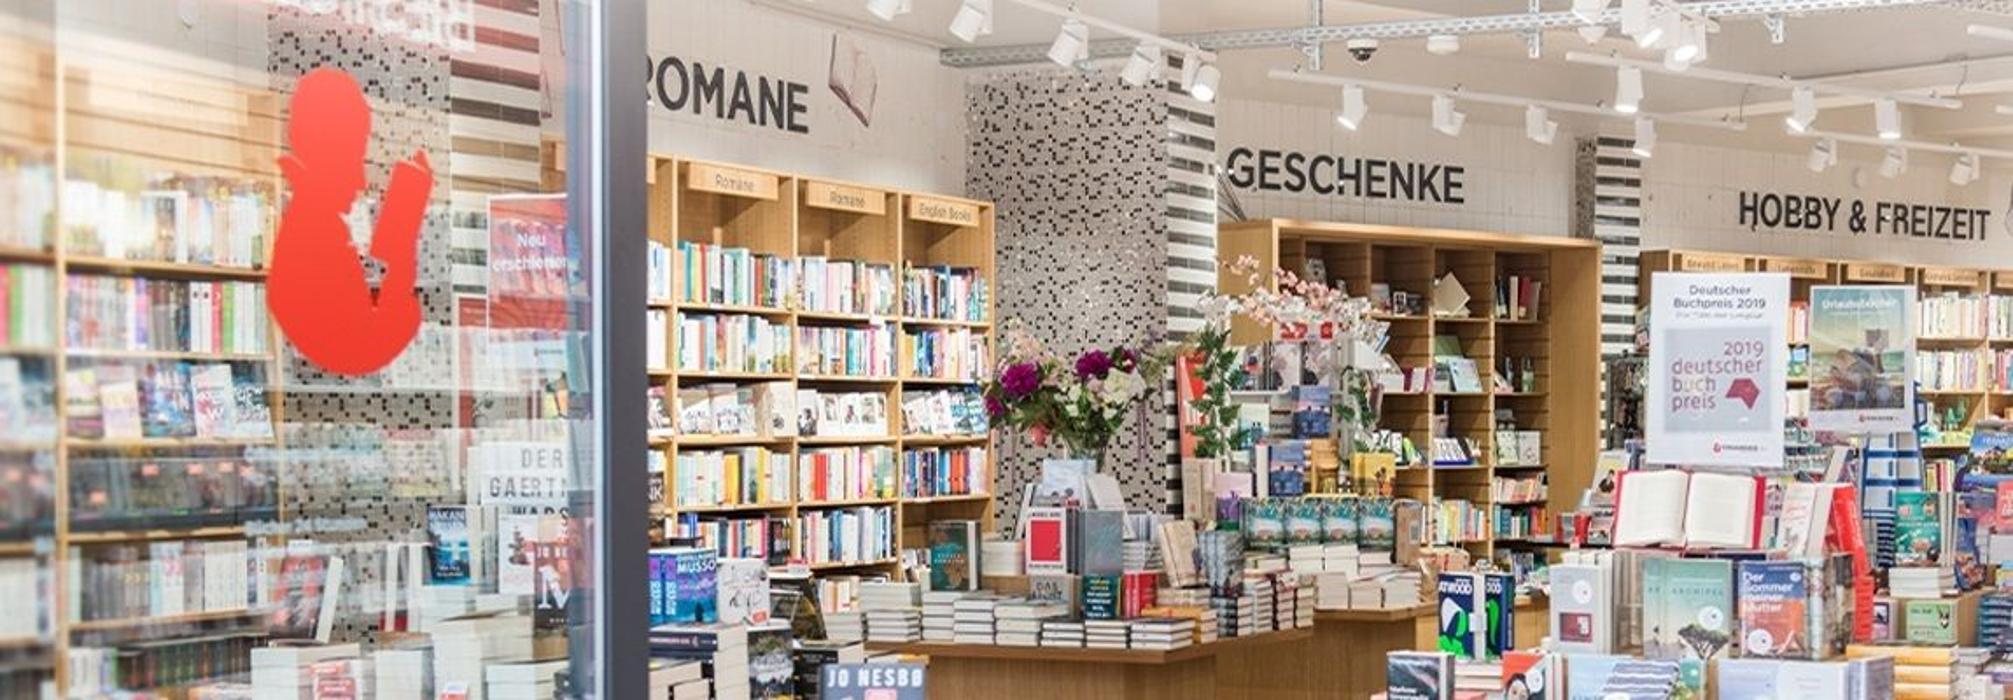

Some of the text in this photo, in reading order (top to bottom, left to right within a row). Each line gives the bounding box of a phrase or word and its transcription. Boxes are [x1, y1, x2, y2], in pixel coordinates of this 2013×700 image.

[1227, 147, 1465, 204] GESCHENKE
[1739, 191, 1991, 241] HOBBY & FREIZEIT
[516, 233, 546, 247] Neu
[1689, 284, 1751, 296] Deutscher
[1673, 298, 1767, 311] Buchpreis 2019
[1724, 341, 1764, 357] 2019
[1672, 358, 1764, 375] deutscher
[1672, 376, 1717, 393] buch
[1672, 395, 1717, 412] preis
[521, 449, 564, 468] DER
[677, 558, 716, 575] MUSSO
[1742, 571, 1765, 582] Der
[1743, 581, 1794, 593] Sommer
[827, 668, 849, 688] JO
